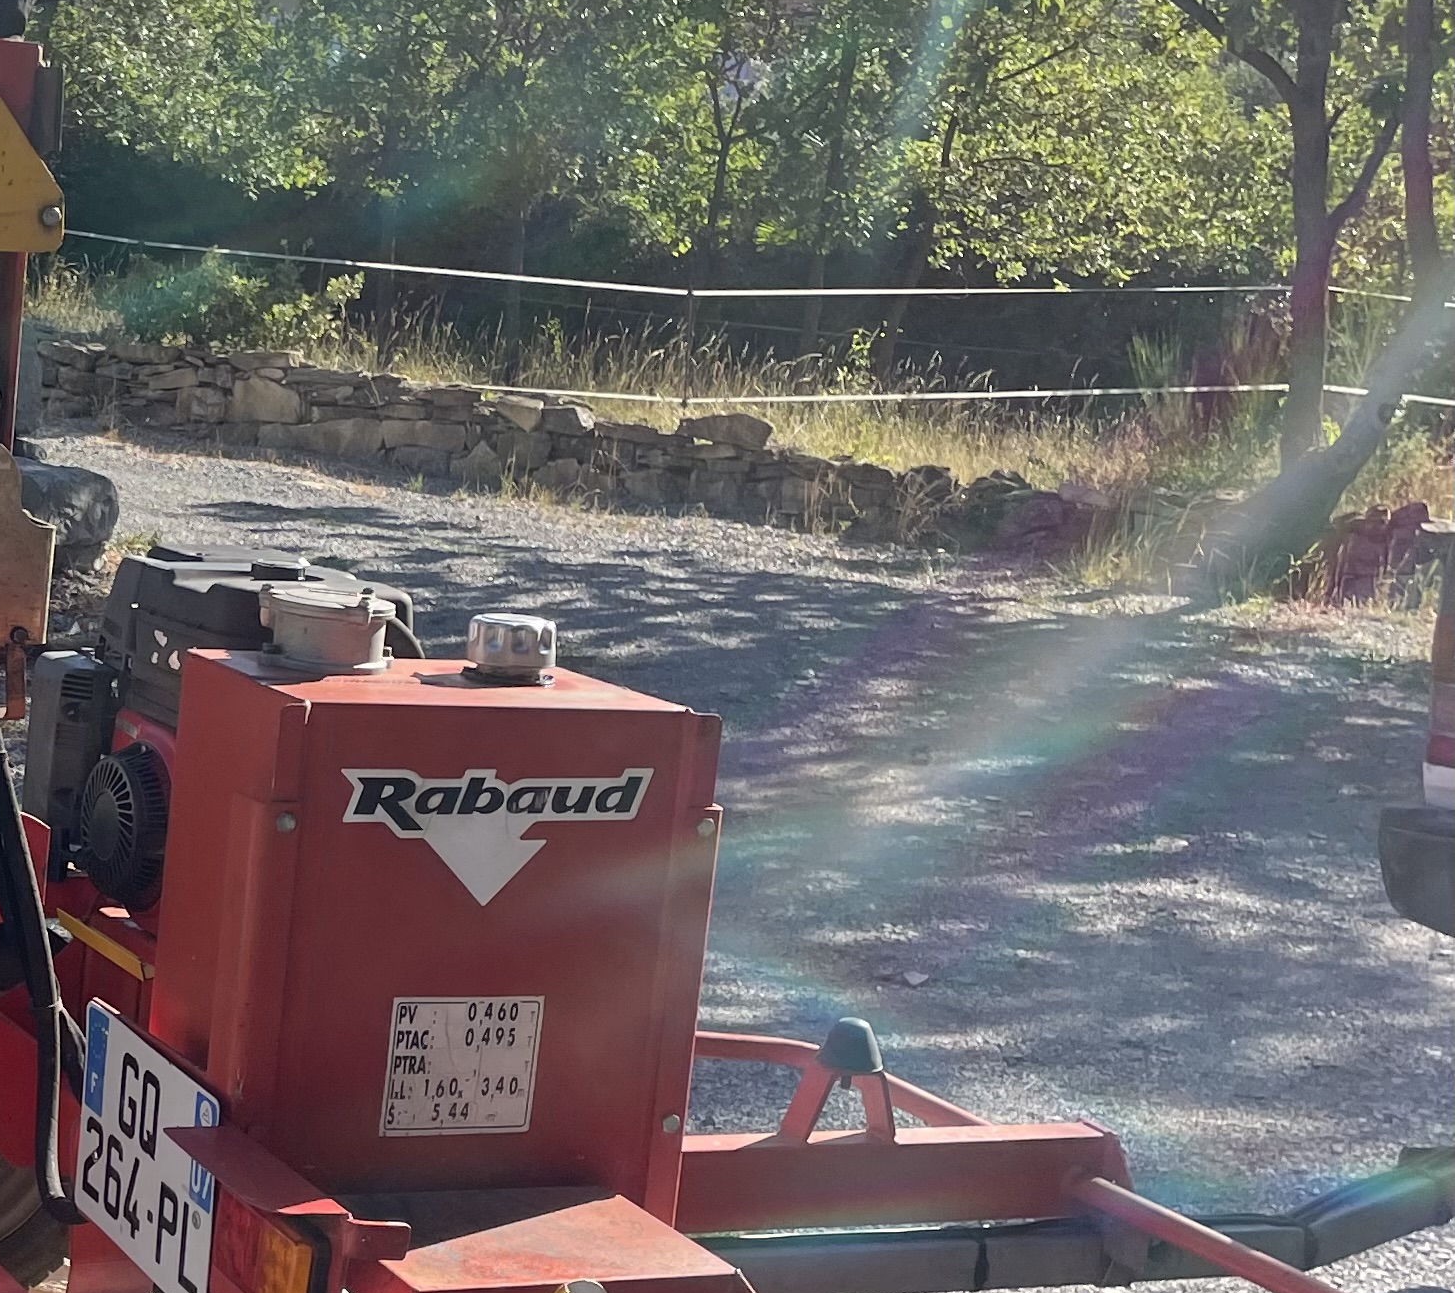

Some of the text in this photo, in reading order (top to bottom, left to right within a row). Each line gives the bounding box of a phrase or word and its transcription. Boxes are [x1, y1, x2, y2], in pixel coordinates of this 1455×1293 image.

[352, 776, 644, 832] Rabaud
[398, 1004, 419, 1025] PV
[468, 1002, 519, 1027] 0,460
[465, 1027, 516, 1052] 0,495
[90, 1071, 99, 1094] F
[118, 1052, 162, 1161] GQ
[431, 1102, 470, 1126] 5,44
